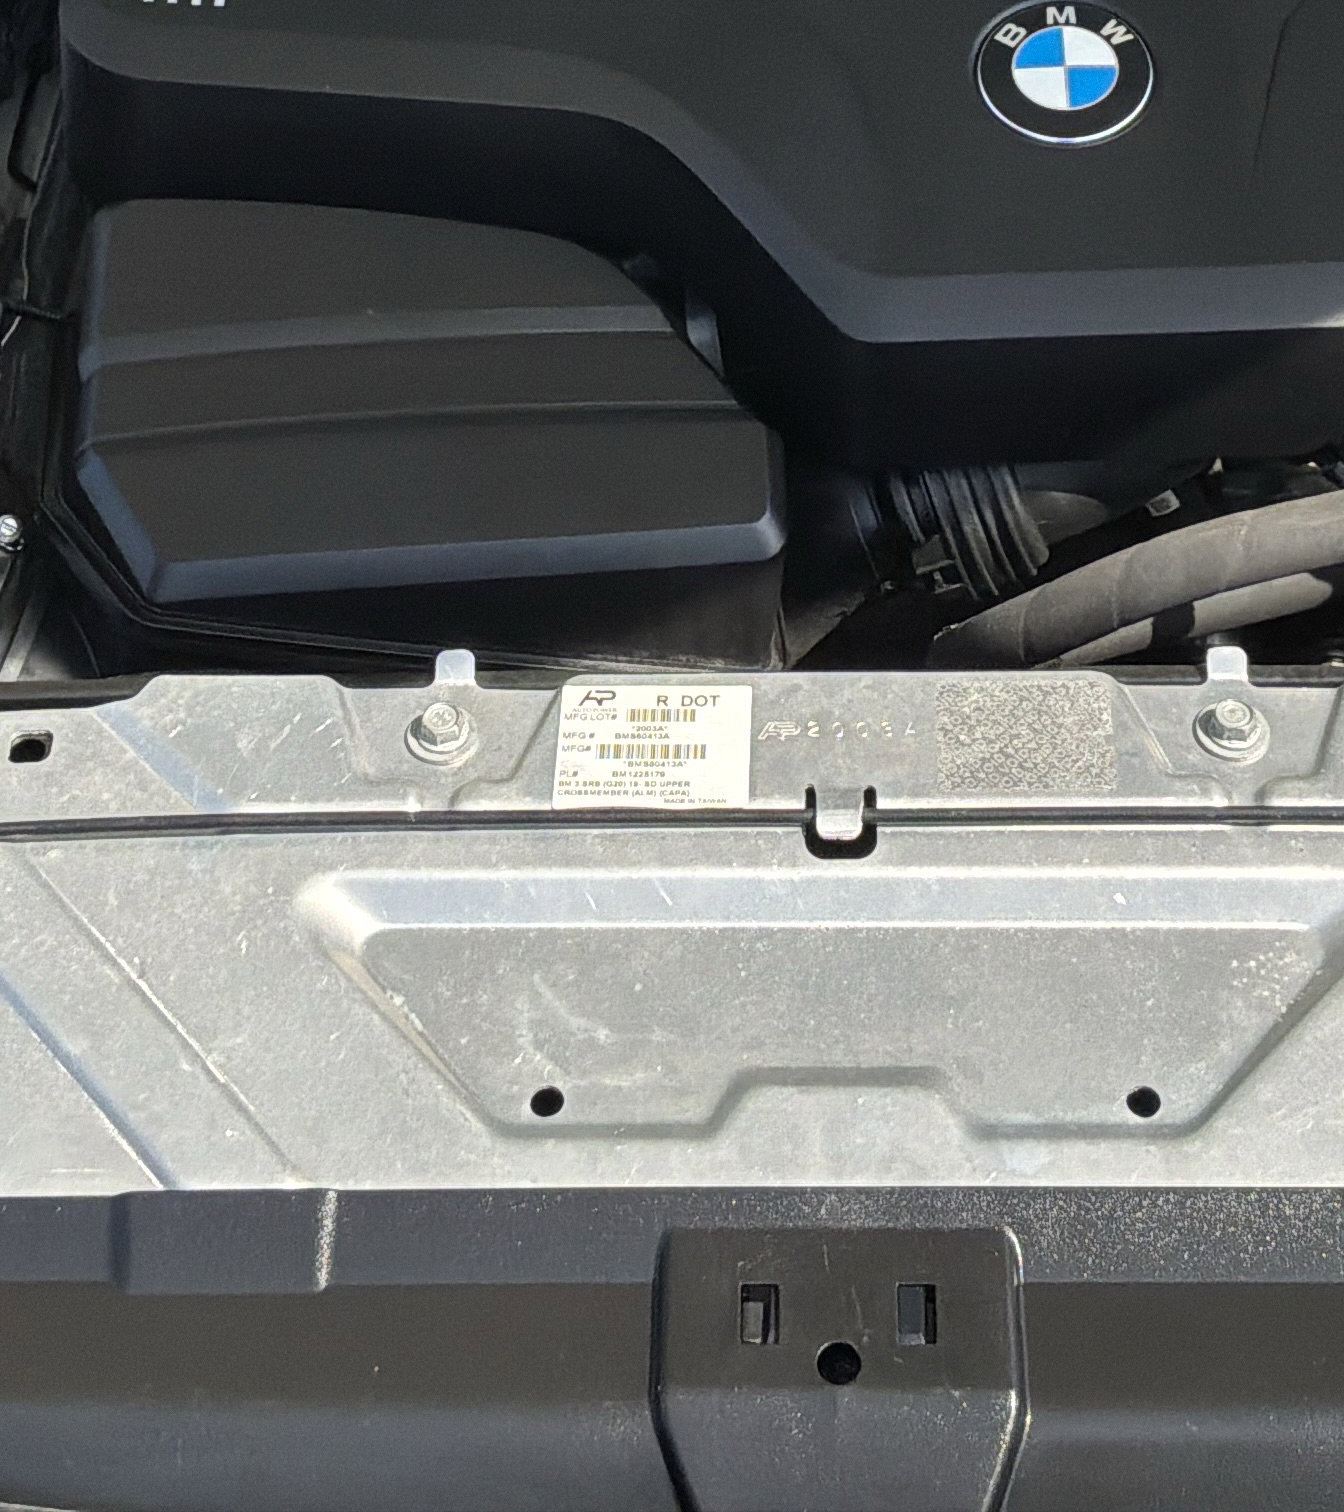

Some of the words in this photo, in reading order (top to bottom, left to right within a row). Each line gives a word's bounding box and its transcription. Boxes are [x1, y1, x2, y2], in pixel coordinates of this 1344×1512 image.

[995, 4, 1135, 49] BMW
[656, 694, 669, 707] R
[680, 694, 721, 707] DOT
[564, 713, 588, 721] MFG
[562, 731, 587, 739] MFG
[659, 780, 691, 788] UPPER
